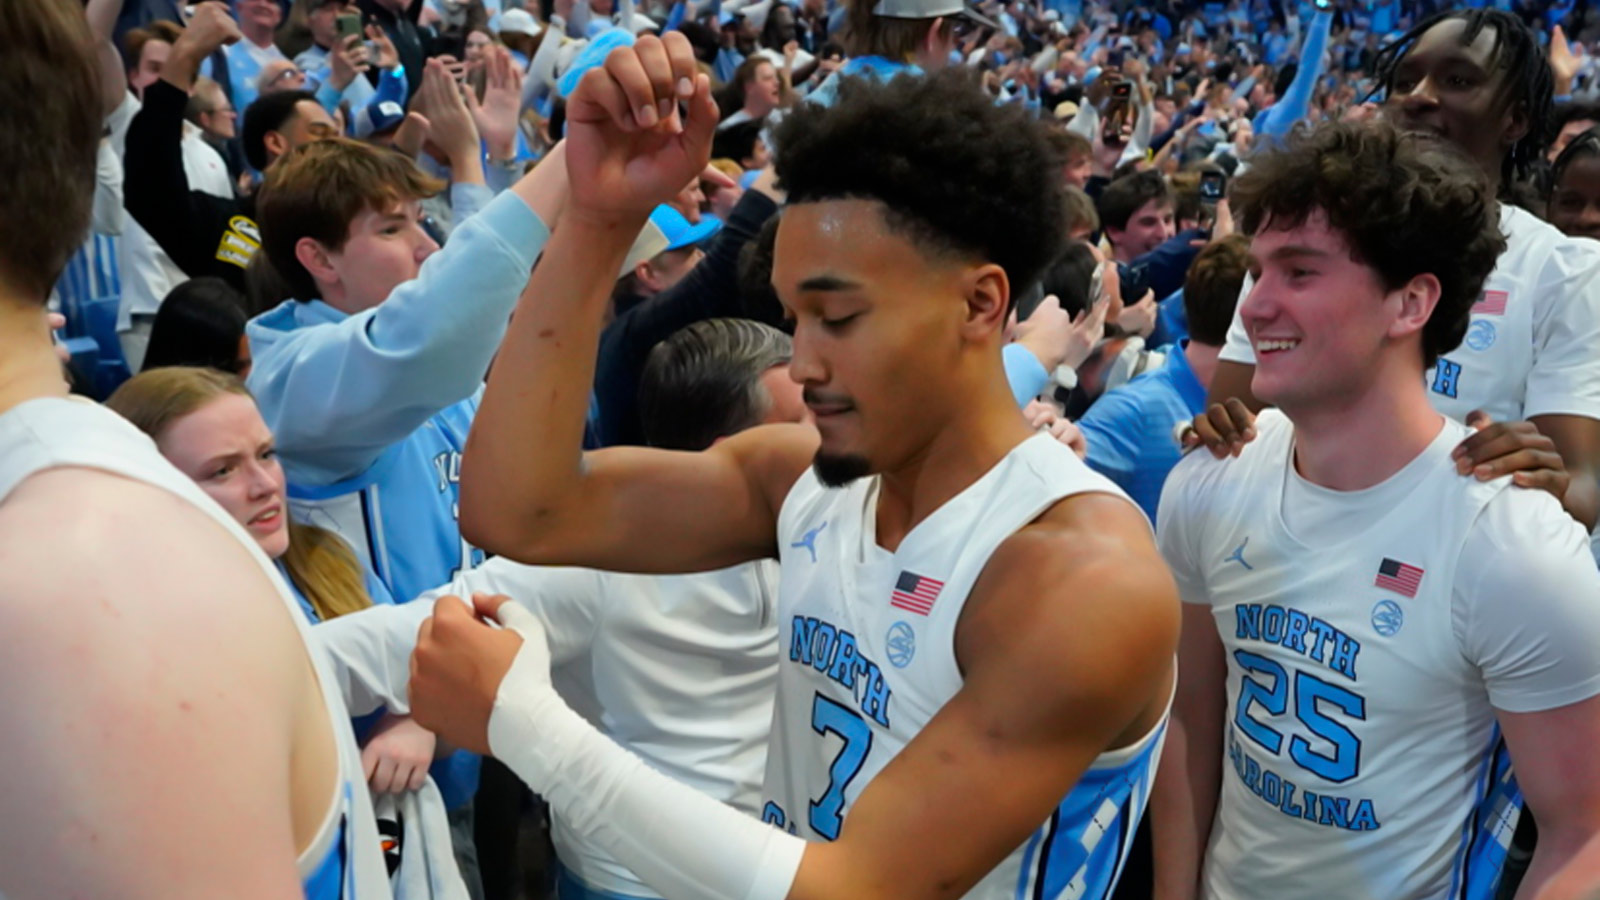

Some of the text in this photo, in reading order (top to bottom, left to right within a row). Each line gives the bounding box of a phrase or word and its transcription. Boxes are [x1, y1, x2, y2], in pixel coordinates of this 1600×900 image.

[1235, 604, 1361, 682] NORTH
[810, 690, 873, 842] 7
[1233, 648, 1366, 783] 25
